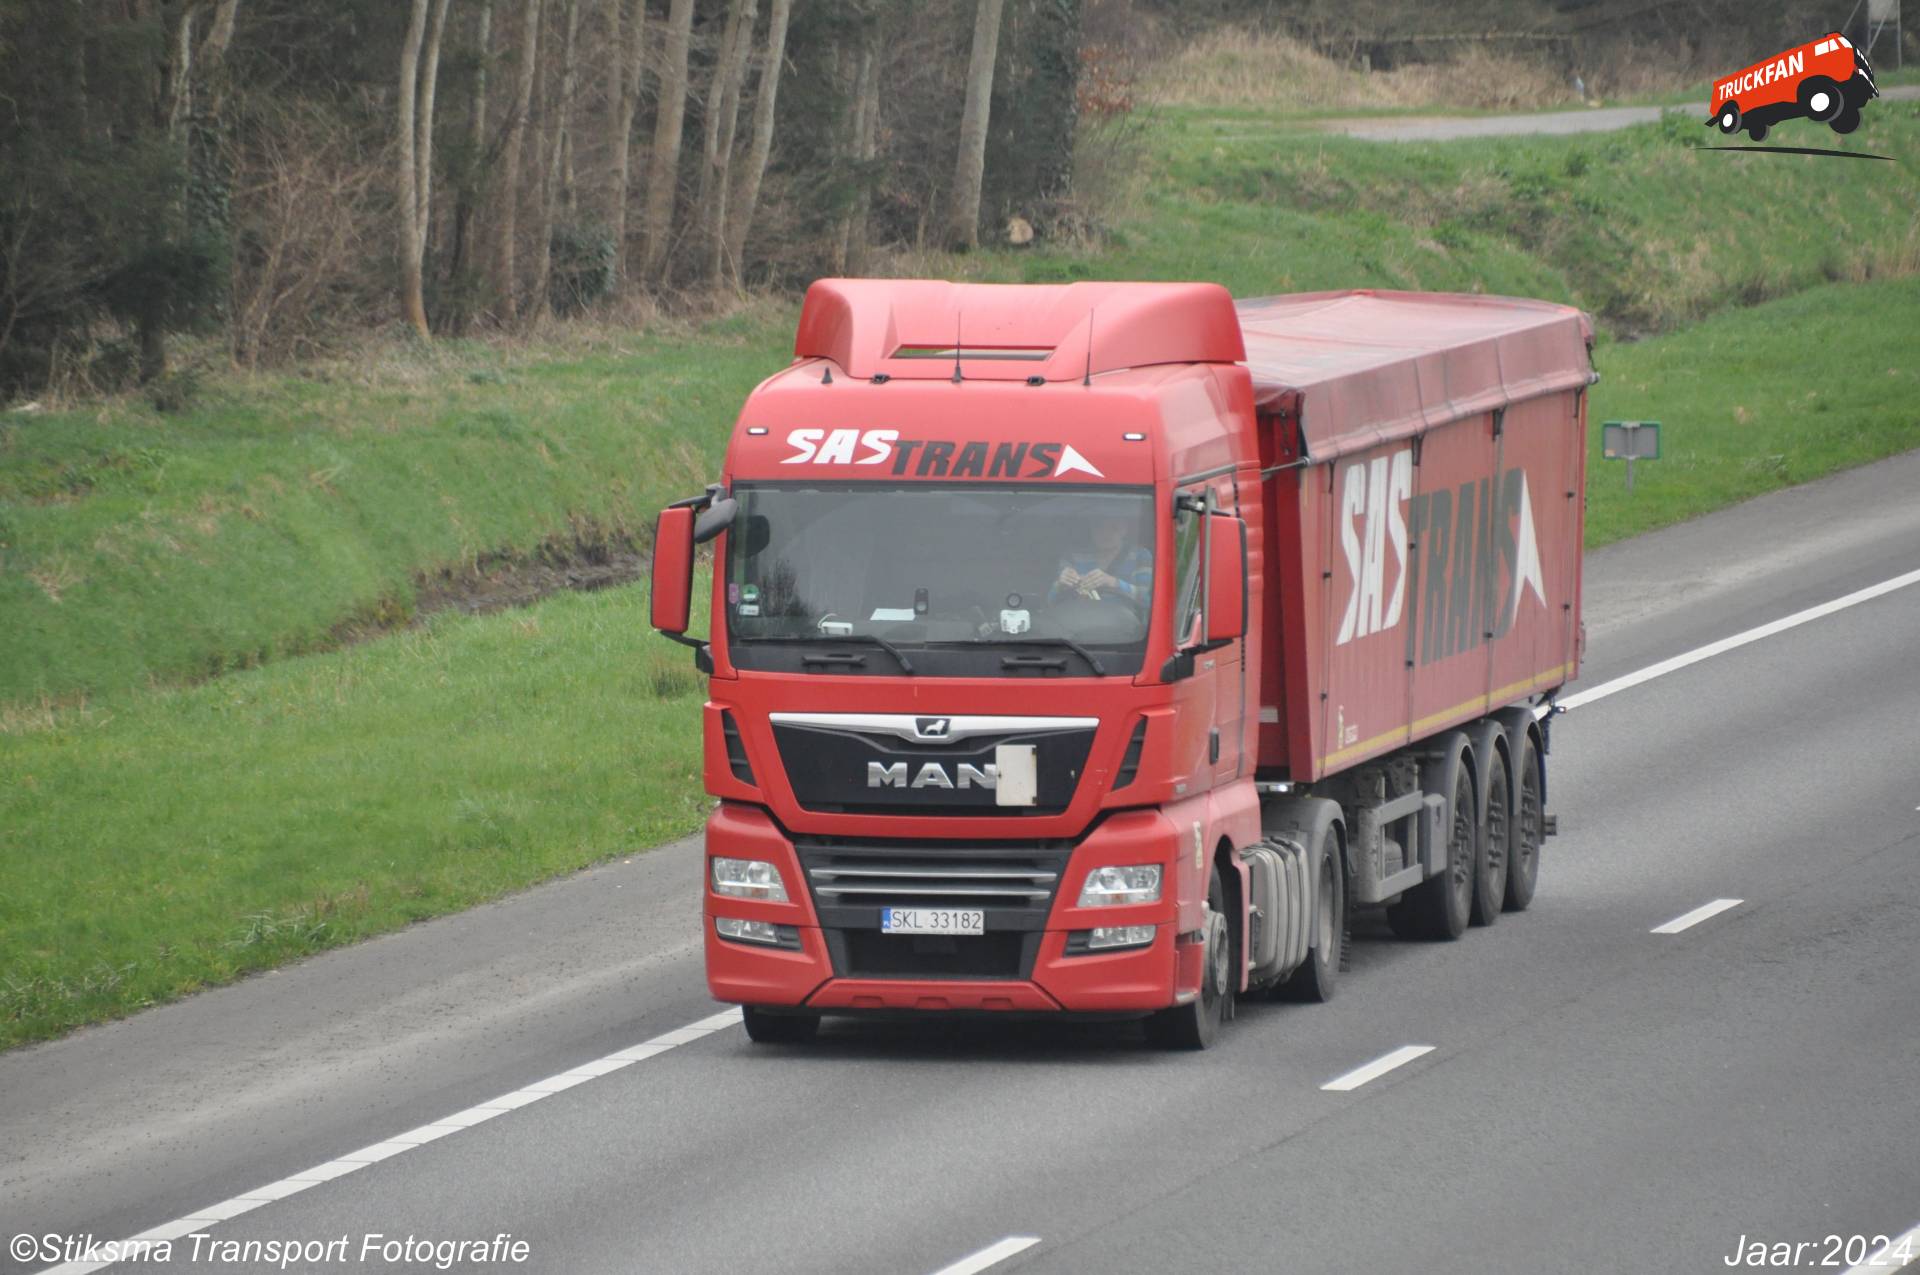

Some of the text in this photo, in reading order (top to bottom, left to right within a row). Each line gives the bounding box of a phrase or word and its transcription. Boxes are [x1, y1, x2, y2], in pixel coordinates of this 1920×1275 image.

[867, 762, 997, 789] MAN
[892, 911, 981, 929] SKL 33182
